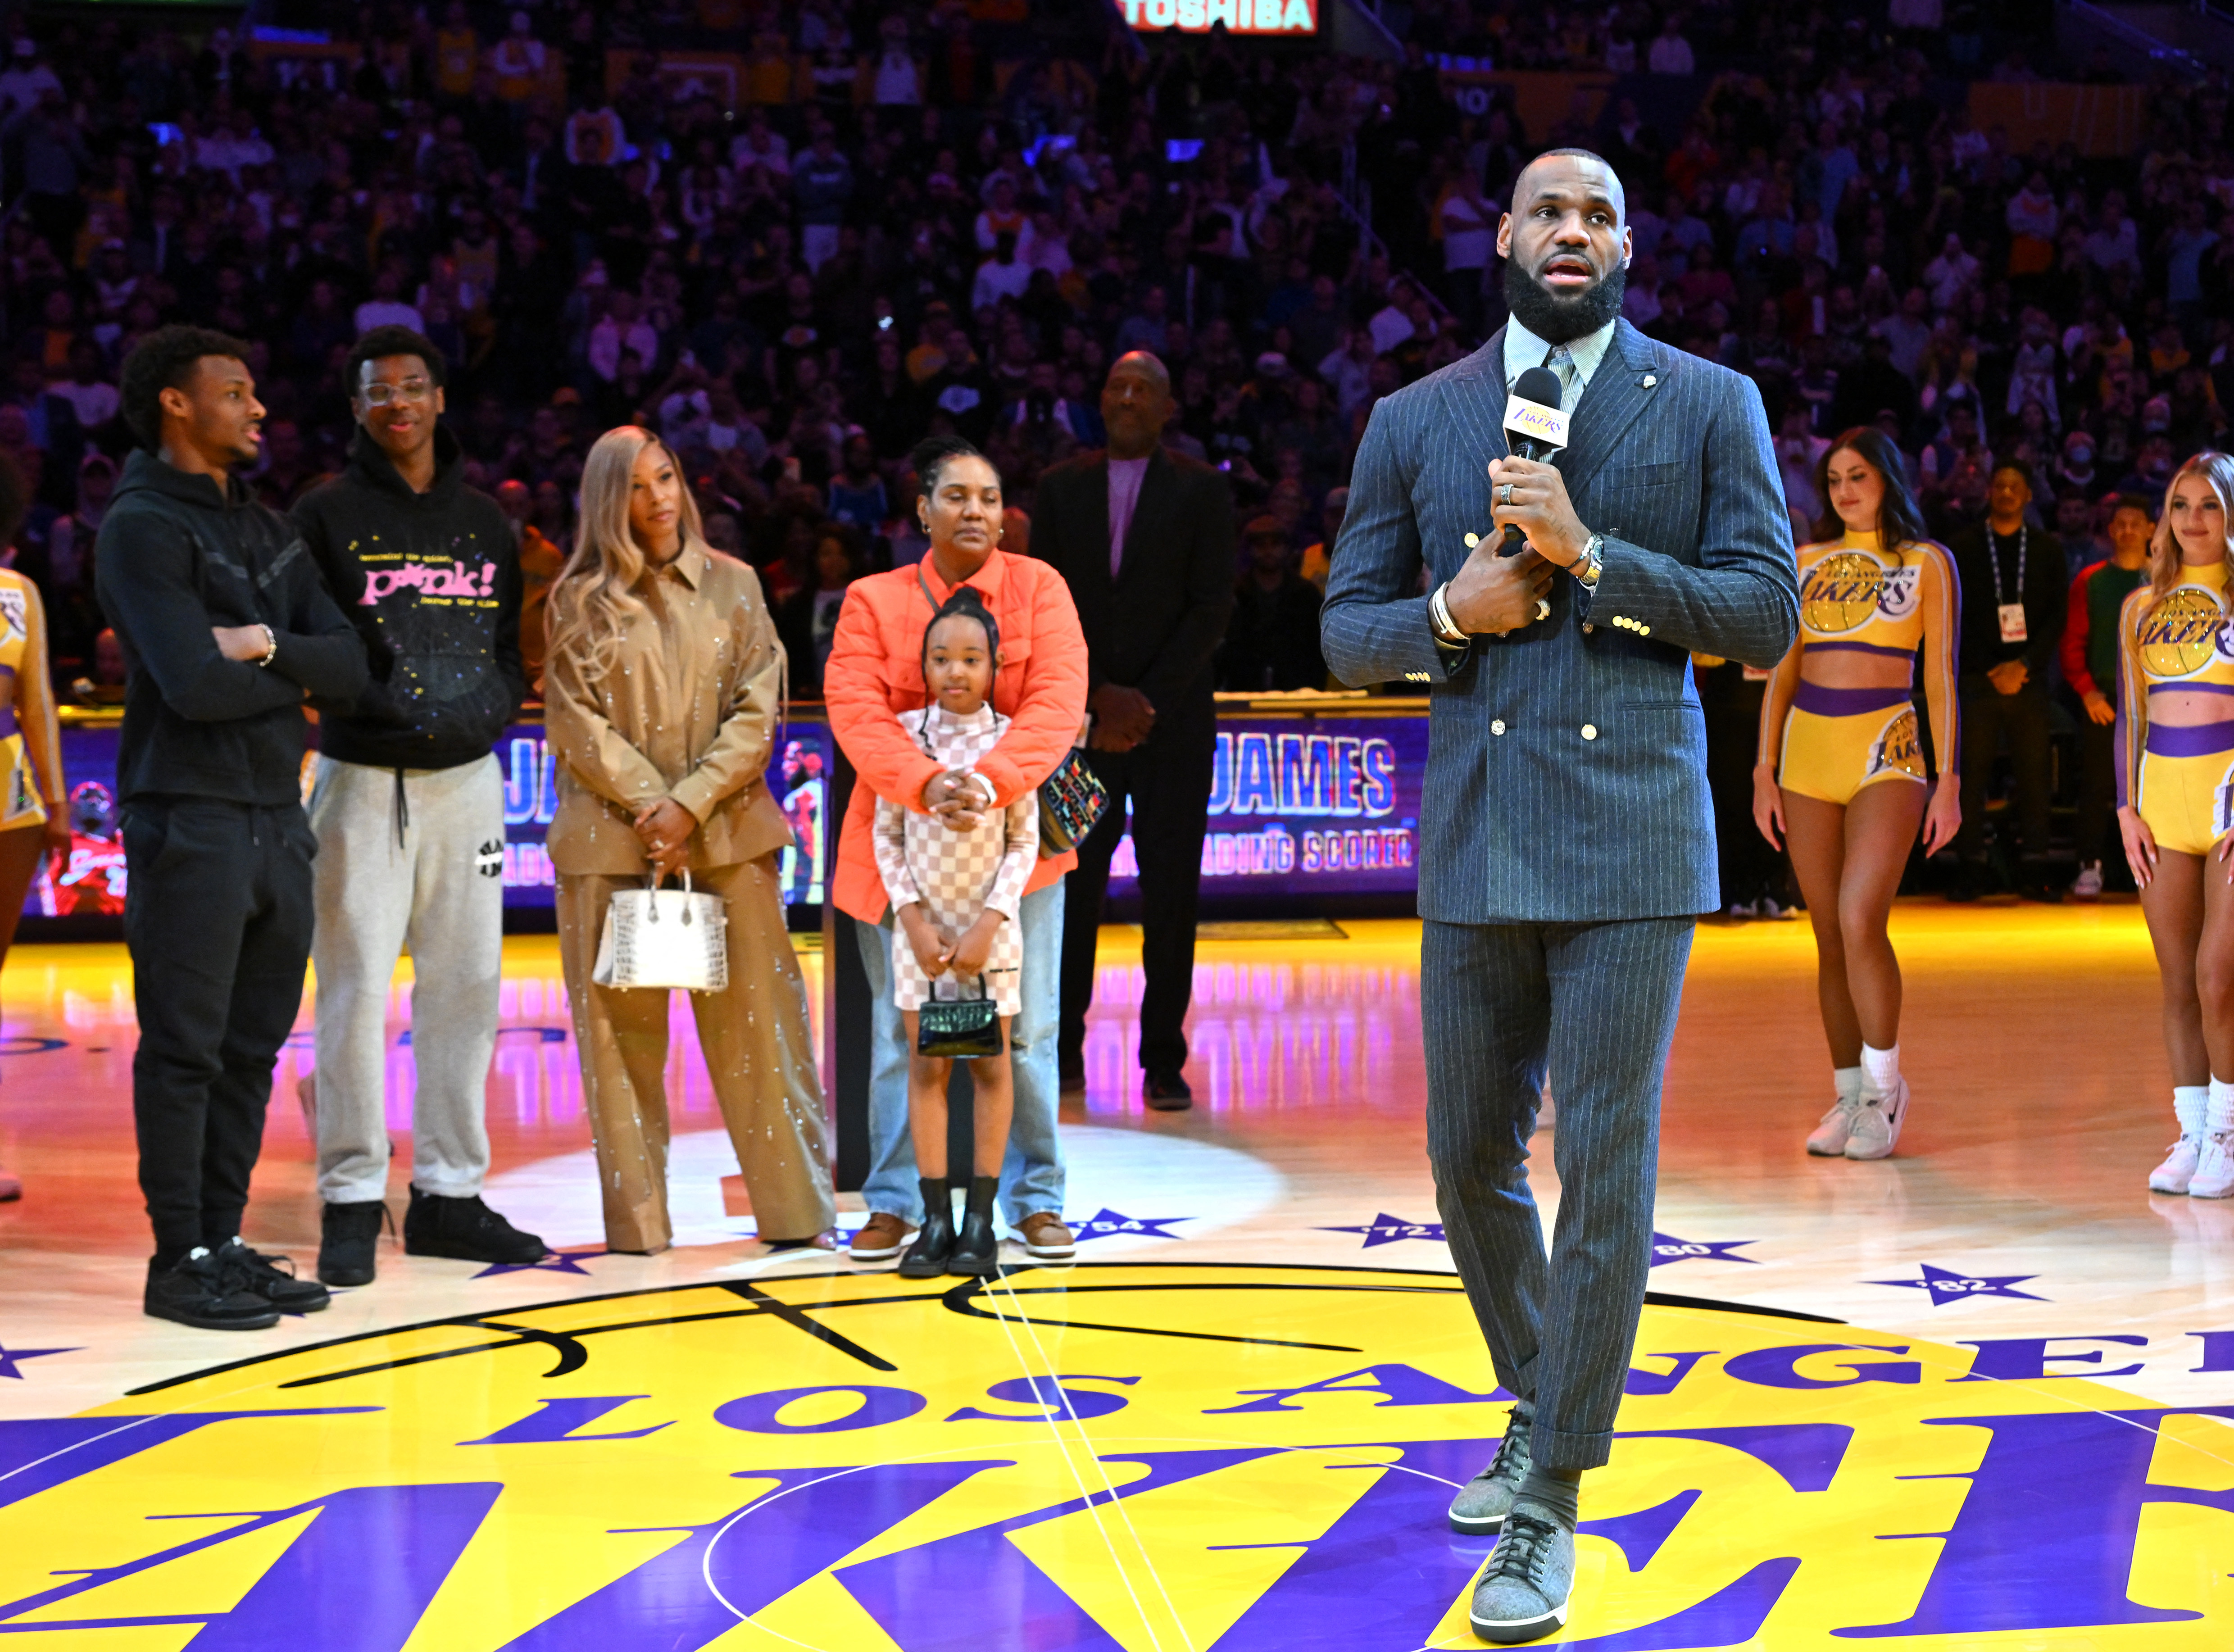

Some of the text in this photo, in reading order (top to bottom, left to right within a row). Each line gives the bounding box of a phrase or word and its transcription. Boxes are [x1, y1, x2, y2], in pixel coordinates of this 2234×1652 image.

[1121, 0, 1313, 31] TOSHIBA
[1513, 408, 1561, 433] LAKERS
[1801, 569, 1912, 616] LAKERS
[1207, 732, 1396, 818] JAMES
[1302, 830, 1413, 872] SCORER
[1916, 1279, 1998, 1293] '82
[455, 1373, 1143, 1447] LOS
